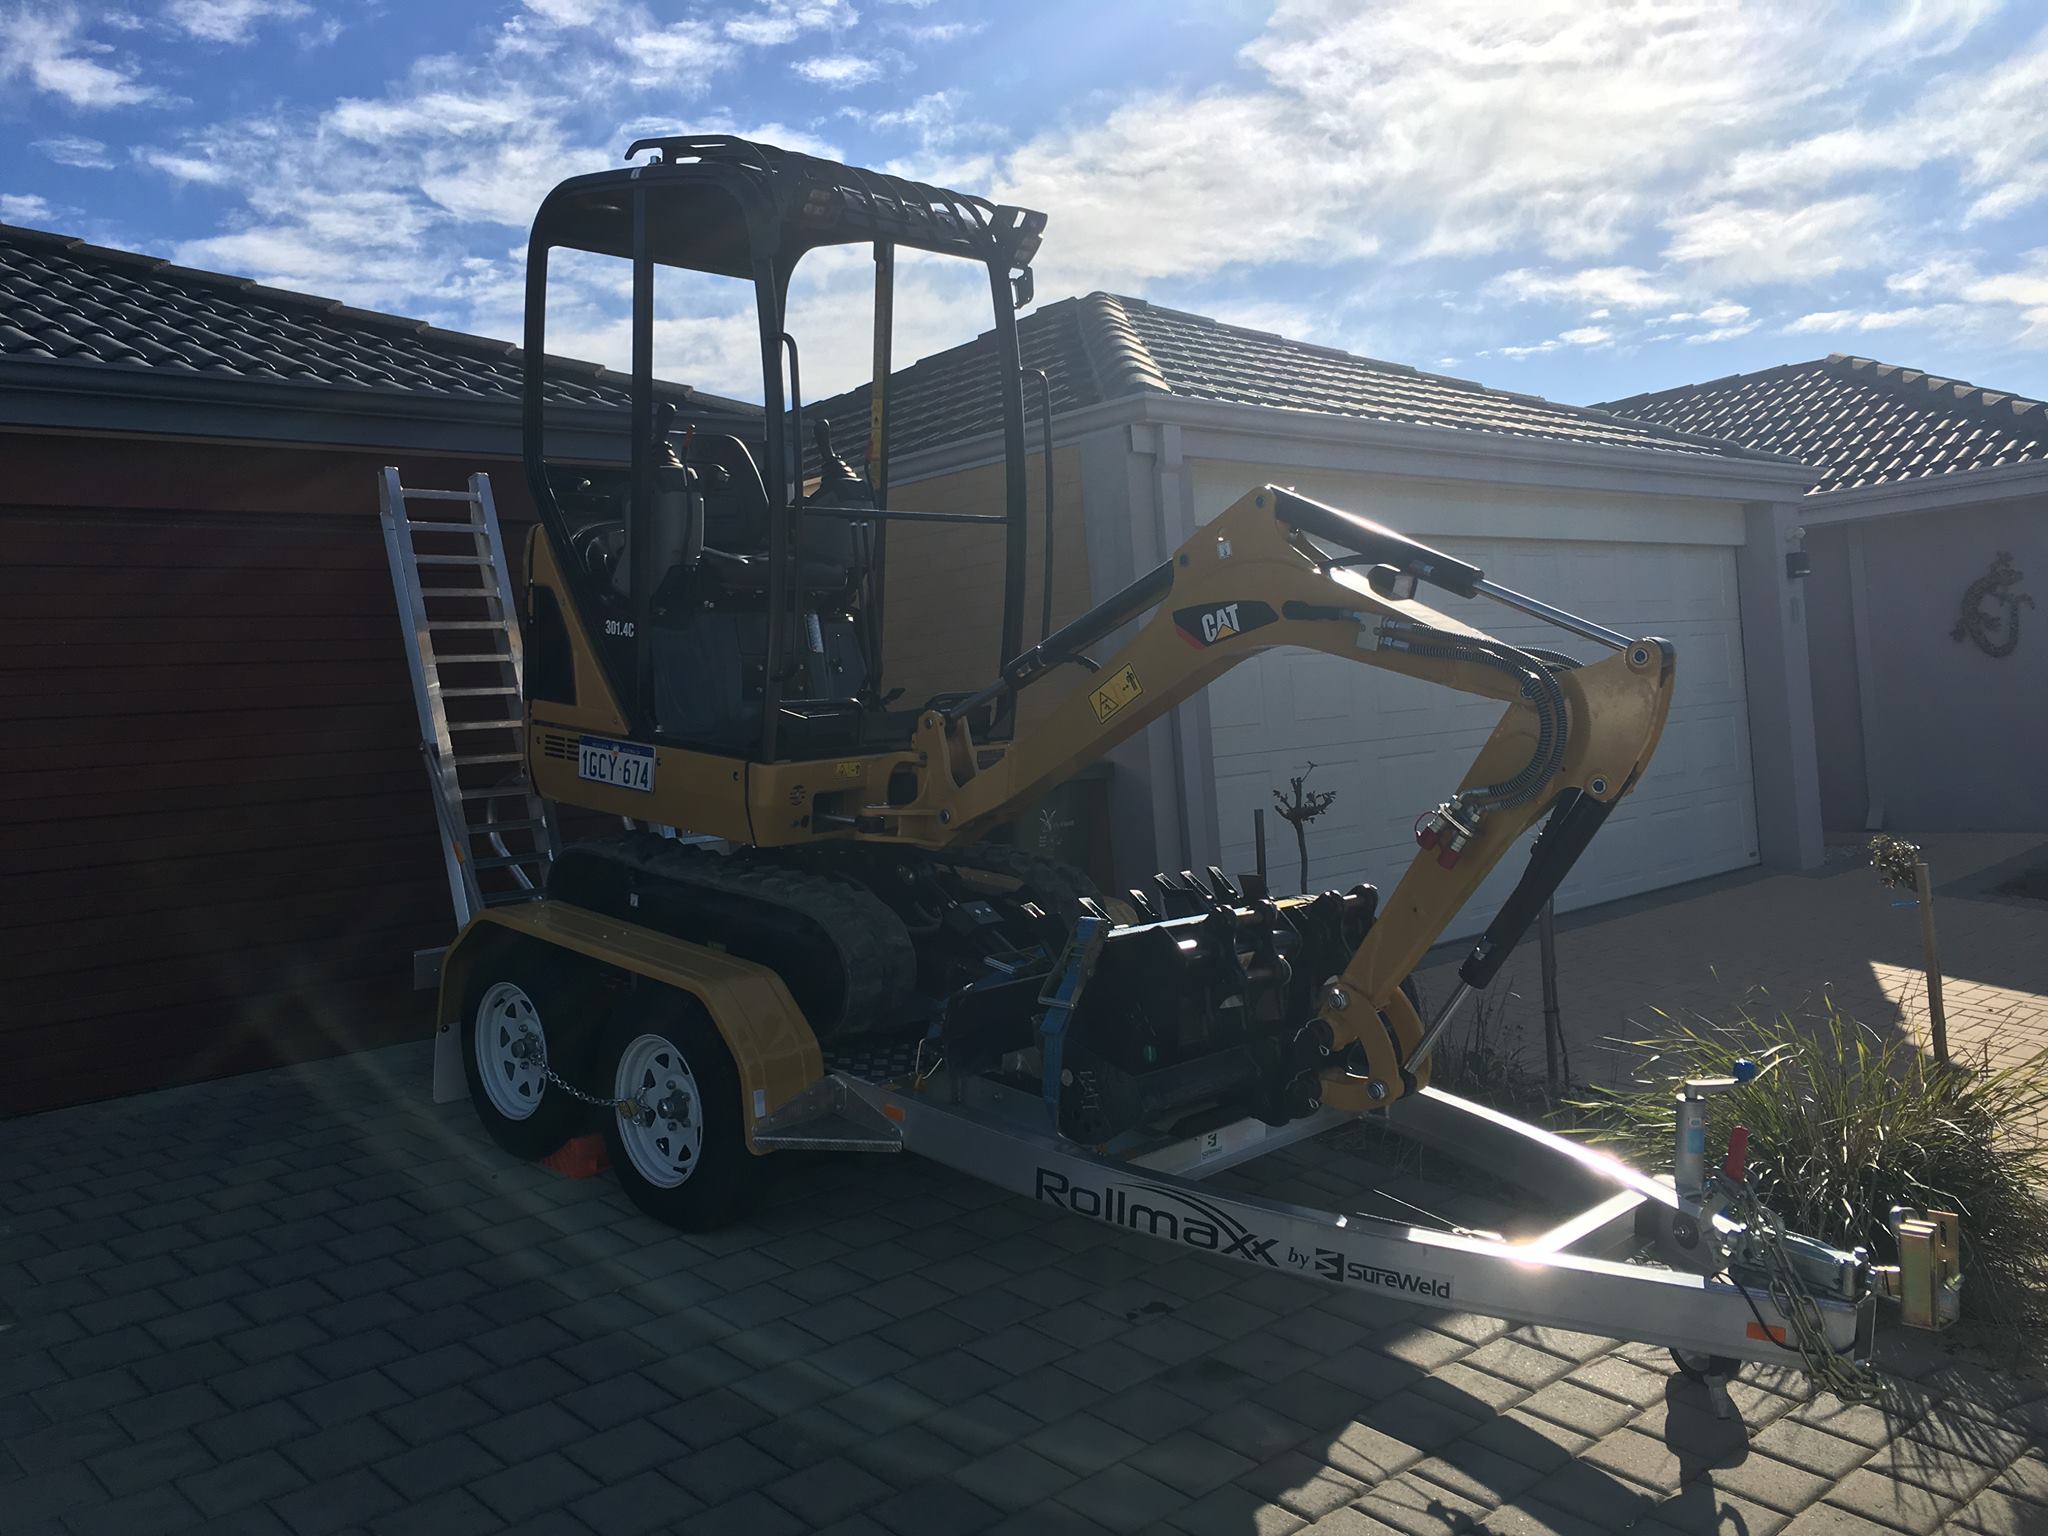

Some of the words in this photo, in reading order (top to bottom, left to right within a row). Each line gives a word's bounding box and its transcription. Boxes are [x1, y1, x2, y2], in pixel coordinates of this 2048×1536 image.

[605, 619, 635, 638] 301.4C
[1202, 603, 1240, 643] CAT
[1036, 1167, 1280, 1267] Rollmaxx
[1288, 1246, 1311, 1269] by
[1347, 1262, 1450, 1300] SureWeld
